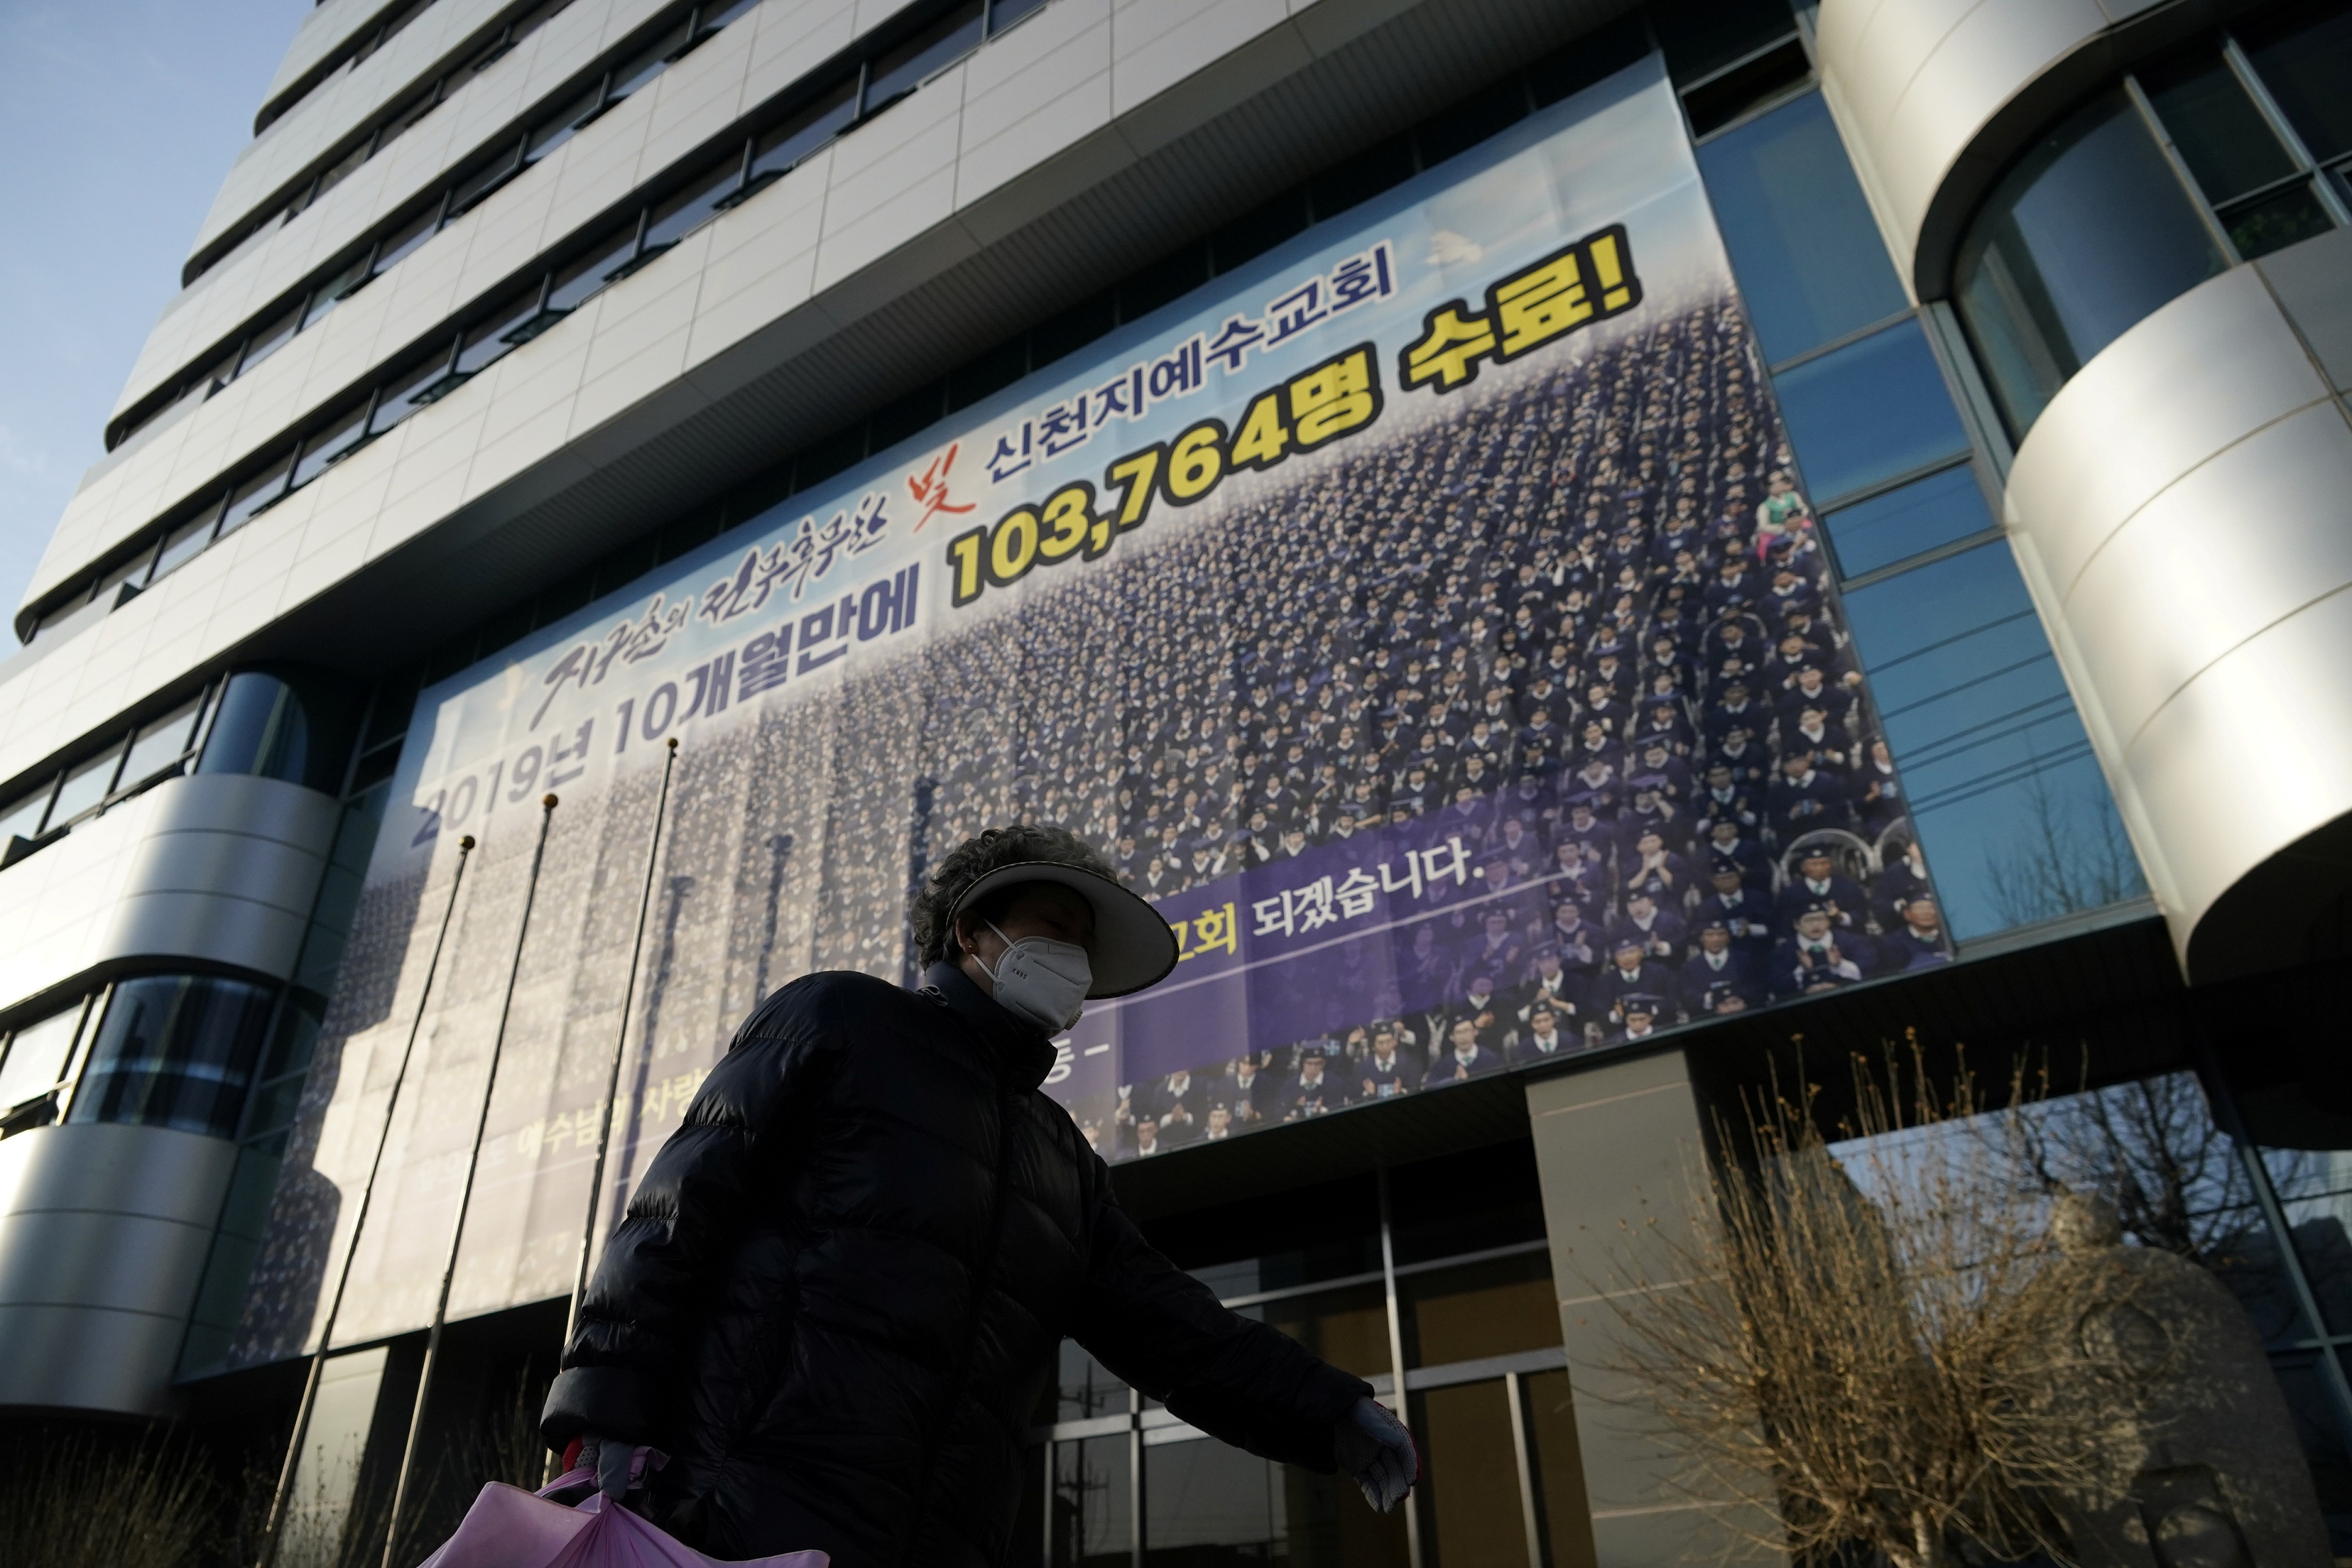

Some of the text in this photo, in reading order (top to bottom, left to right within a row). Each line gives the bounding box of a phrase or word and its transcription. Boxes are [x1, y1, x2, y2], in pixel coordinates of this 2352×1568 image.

[410, 224, 1642, 848] 2019년 10개월만에 103,764명 수료!
[530, 245, 1392, 731] 지구촌의 전무후무한 빛 신천지예수교회
[639, 1068, 712, 1123] 사랑
[1252, 836, 1485, 937] 되겠습니다.
[1011, 967, 1027, 979] KN95
